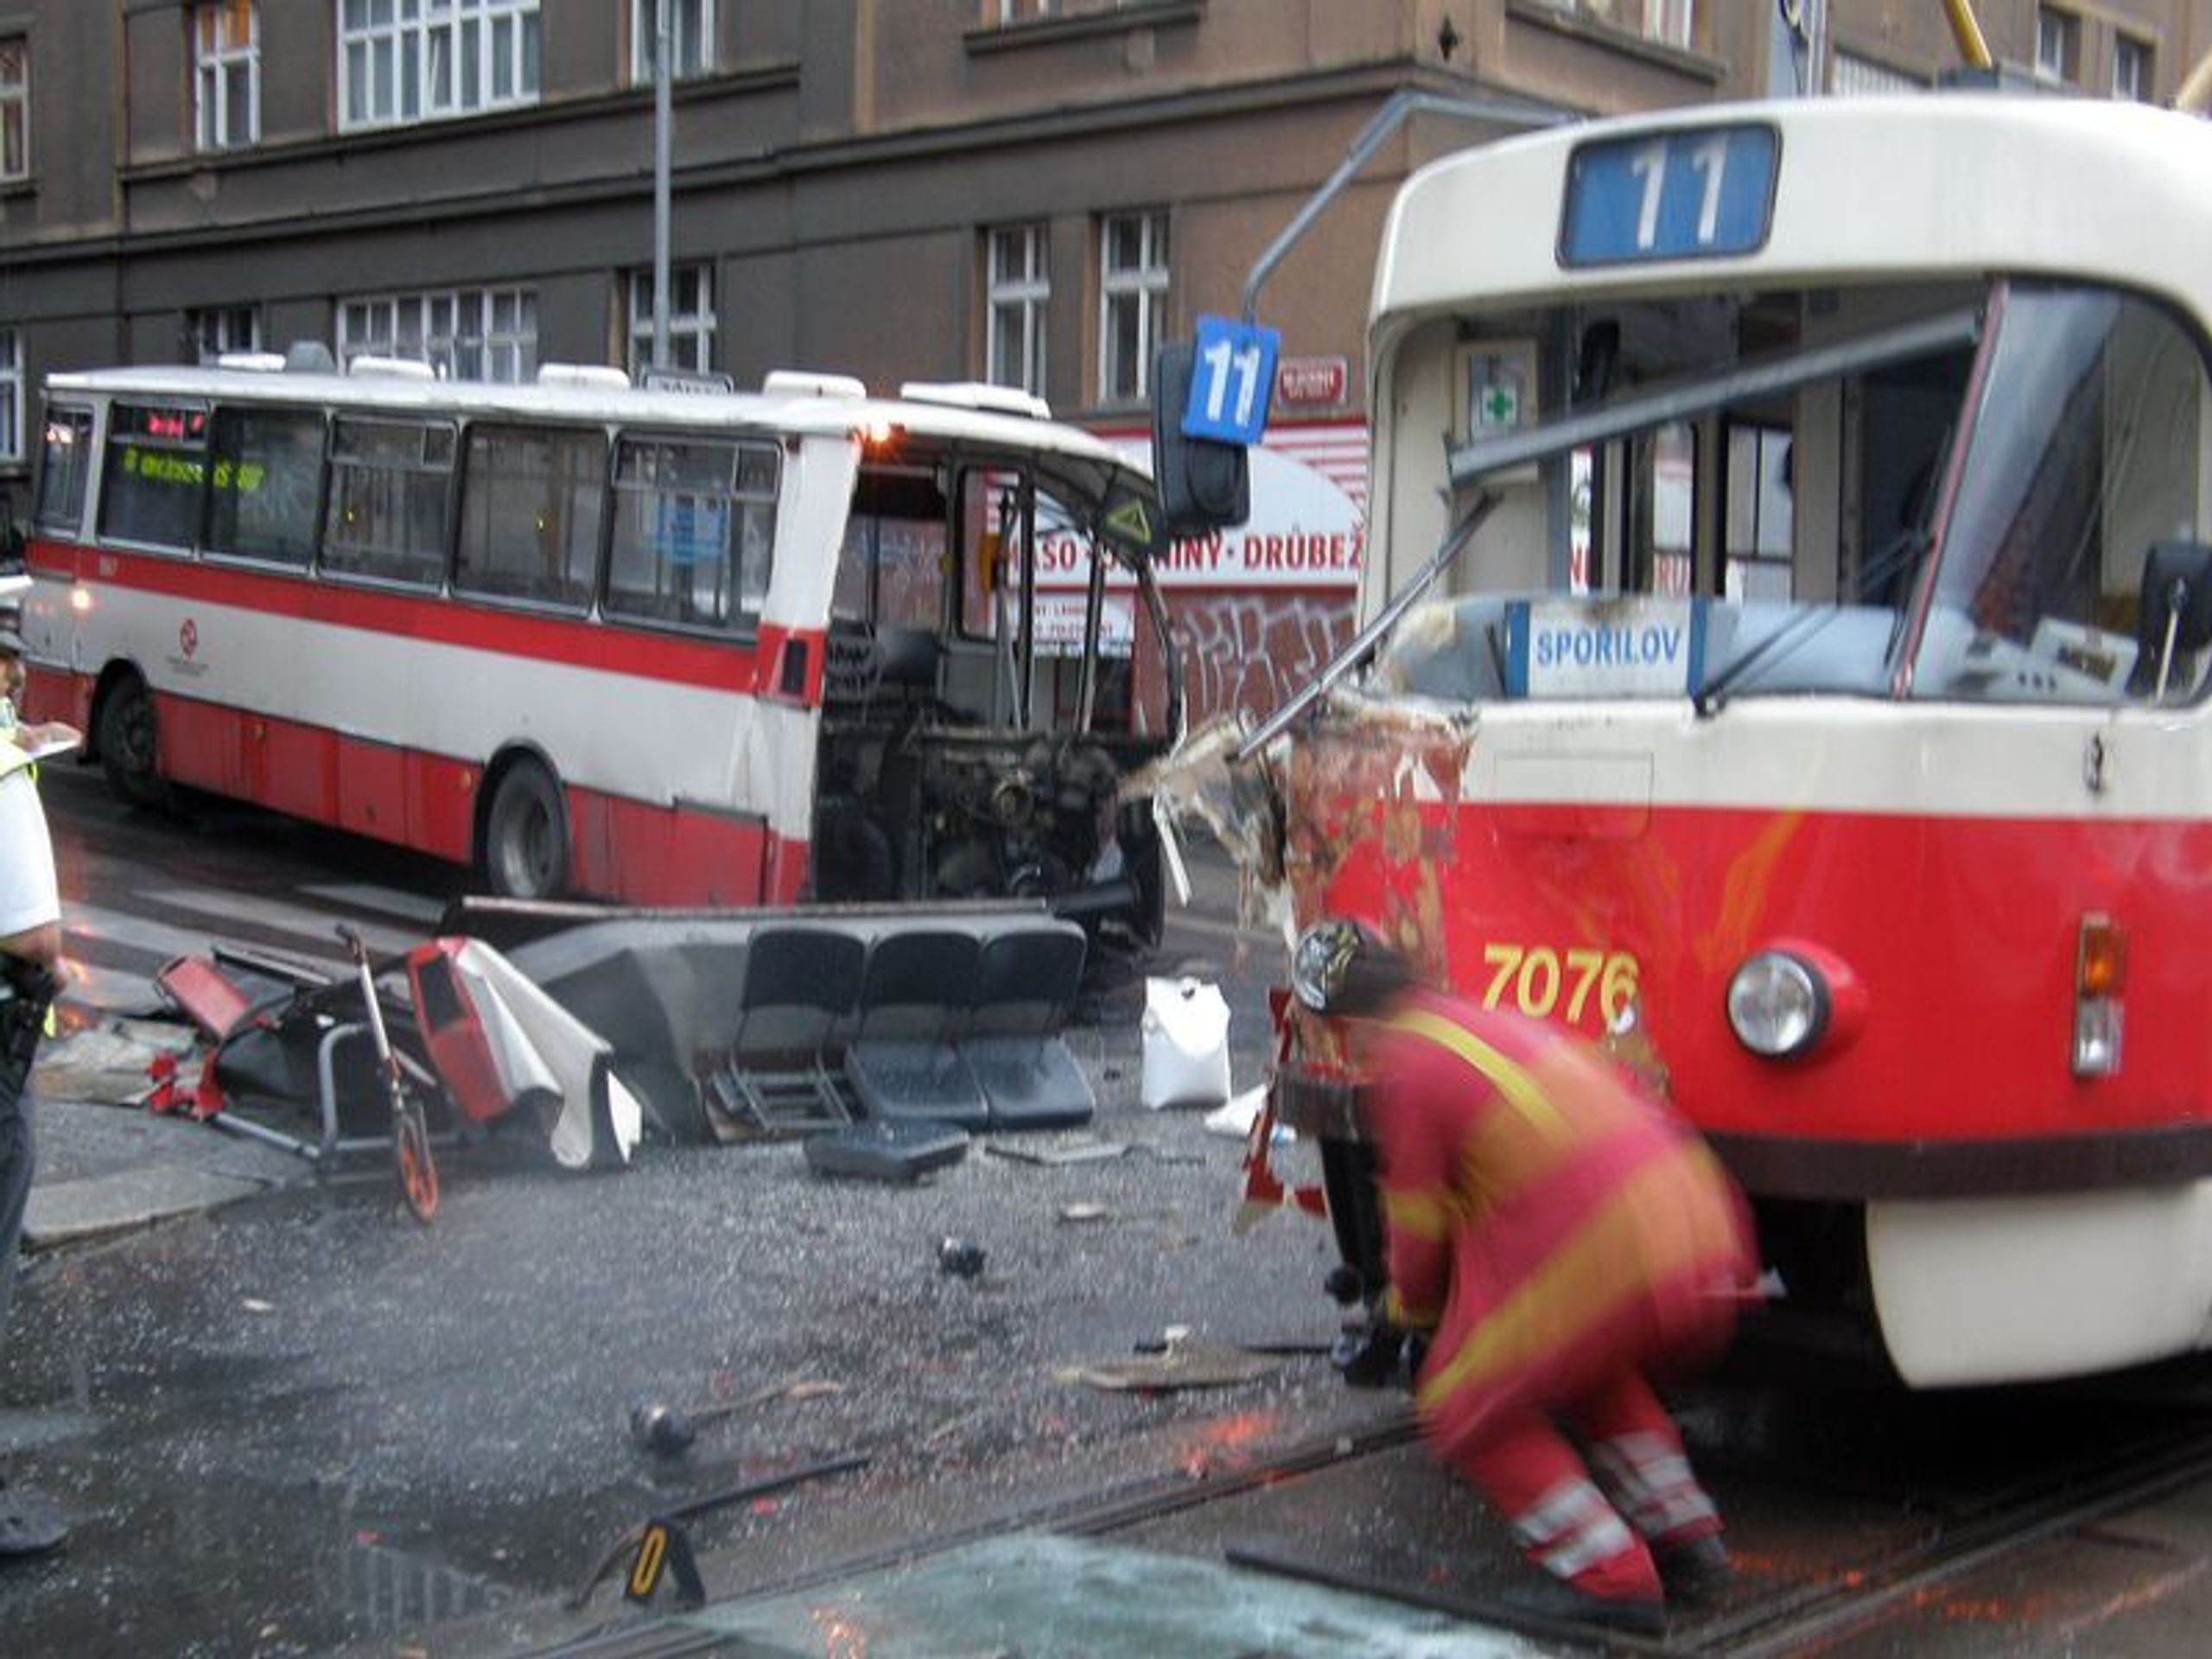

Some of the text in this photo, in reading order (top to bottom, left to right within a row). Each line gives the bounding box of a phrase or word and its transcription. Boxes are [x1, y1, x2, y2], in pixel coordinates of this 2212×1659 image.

[1631, 135, 1727, 250] 11
[1204, 340, 1261, 429] 11
[1482, 944, 1639, 1034] 7076
